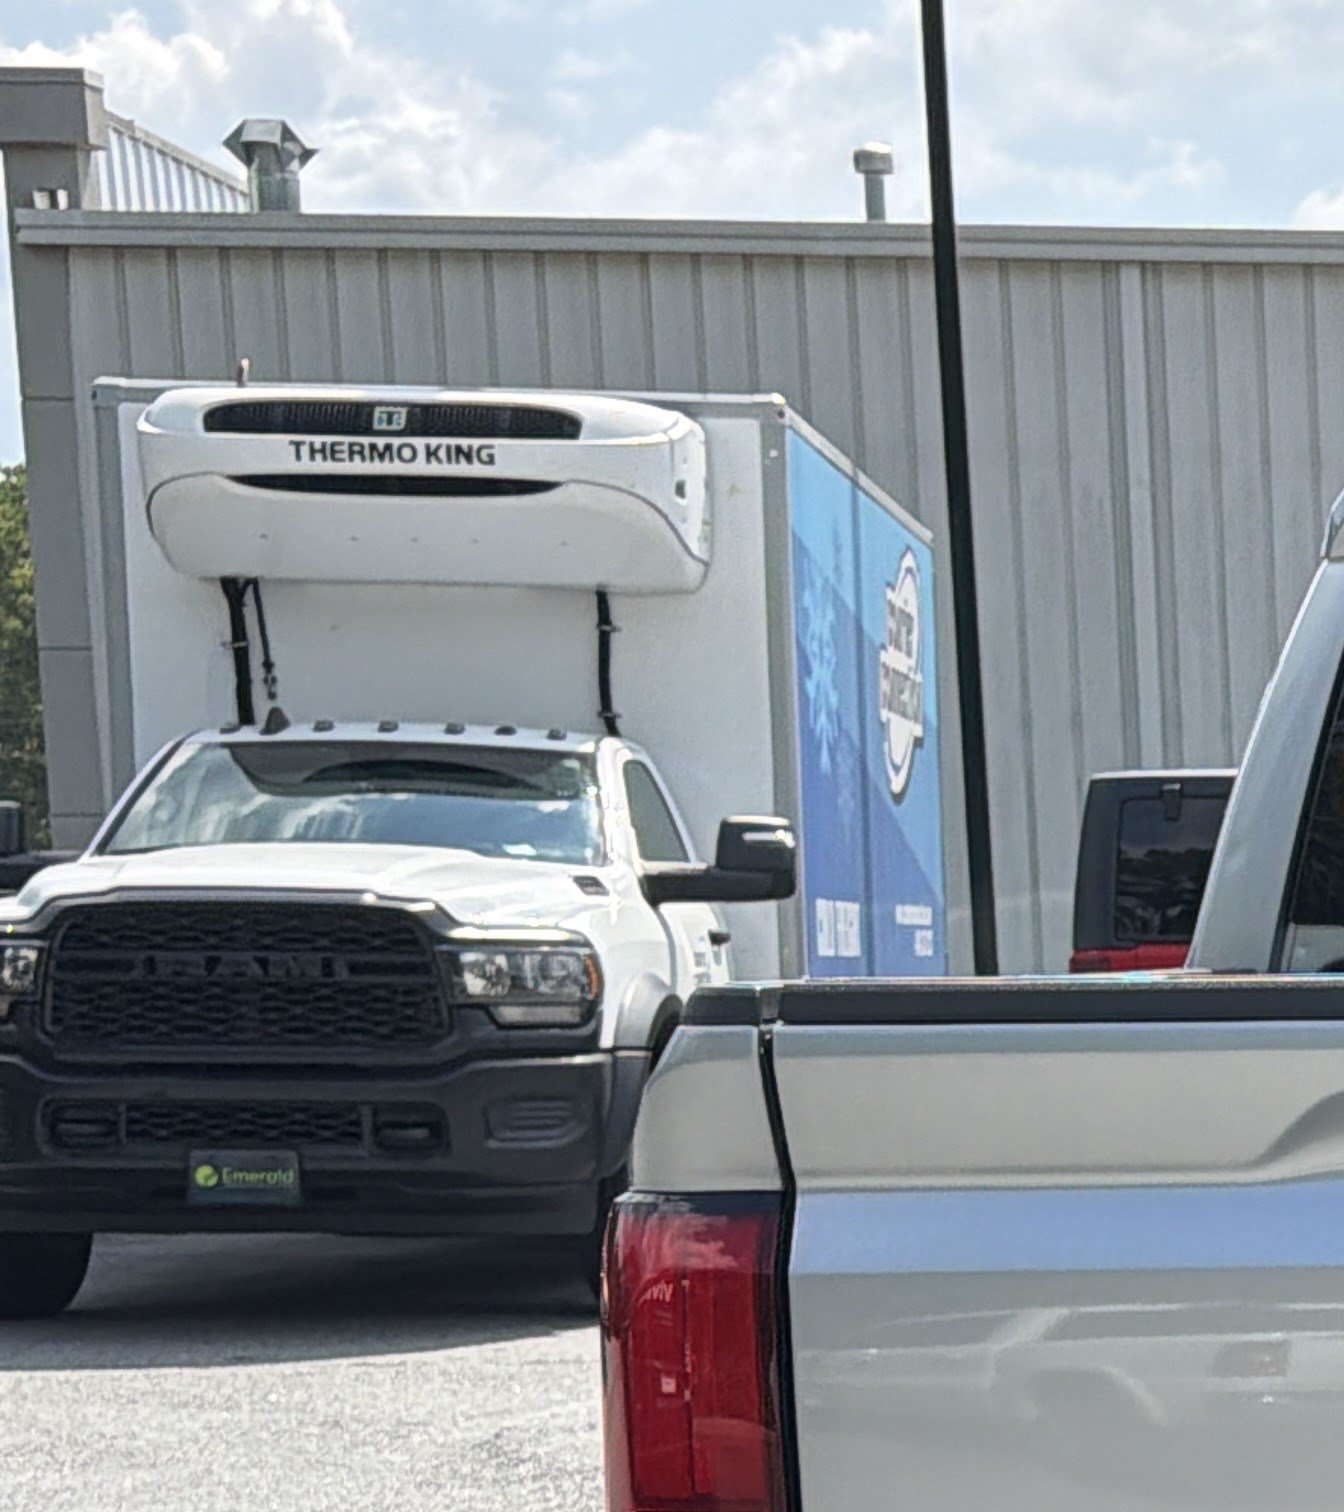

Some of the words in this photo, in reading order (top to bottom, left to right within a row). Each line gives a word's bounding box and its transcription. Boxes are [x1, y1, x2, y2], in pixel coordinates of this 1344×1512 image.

[288, 440, 418, 464] THERMO
[424, 443, 496, 465] KING
[222, 1166, 294, 1184] Emerald
